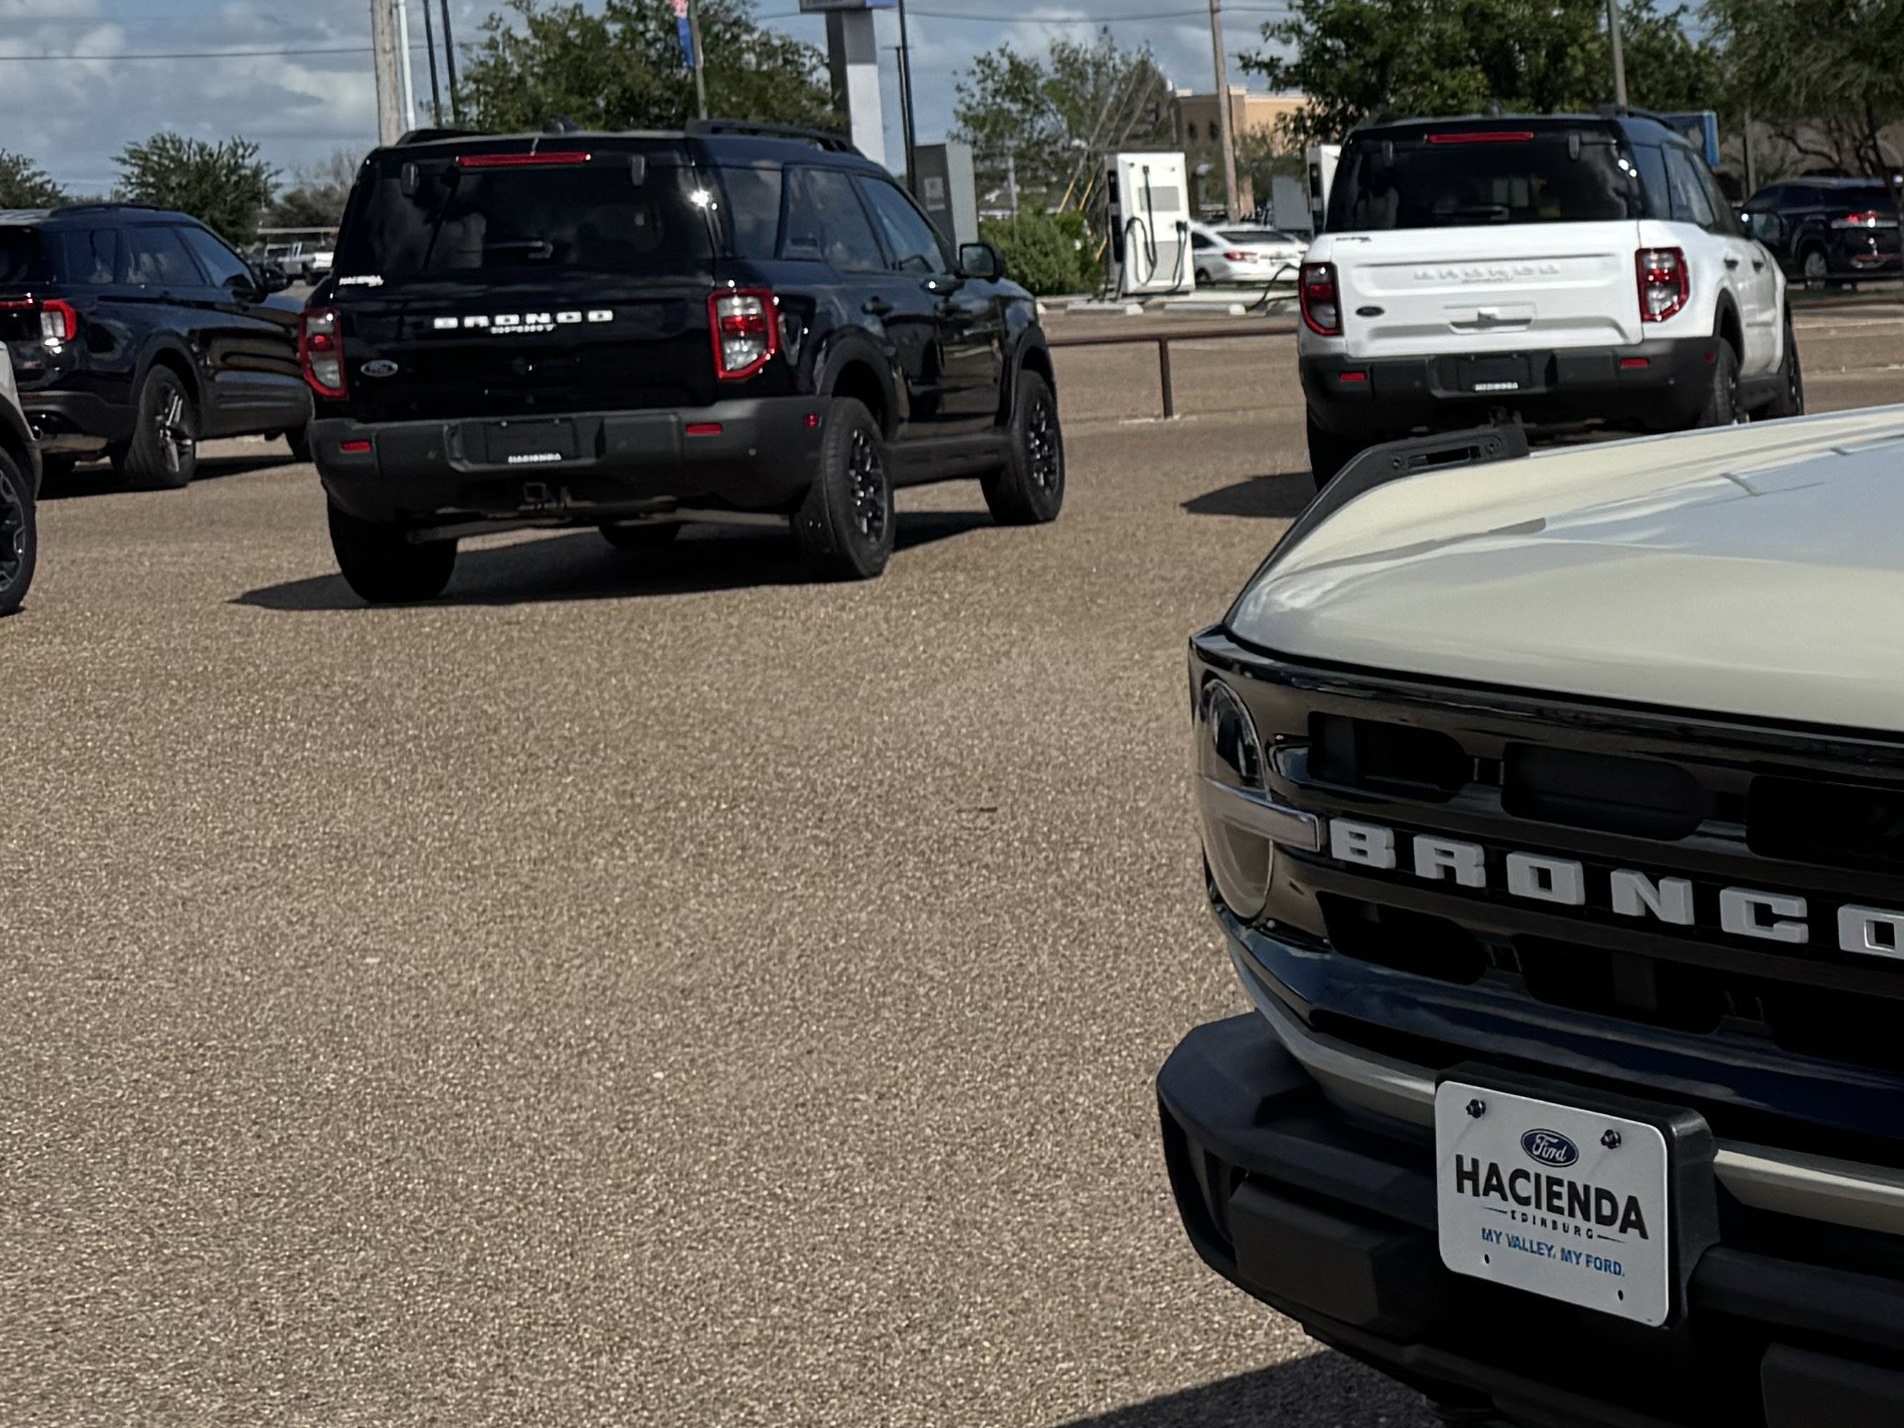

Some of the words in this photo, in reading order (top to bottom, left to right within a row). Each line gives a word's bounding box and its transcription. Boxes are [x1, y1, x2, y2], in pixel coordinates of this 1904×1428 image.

[434, 310, 613, 329] BRONCO
[1532, 1133, 1567, 1162] Ford
[1455, 1154, 1649, 1240] HACIENDA
[1510, 1209, 1594, 1239] EDINBURG
[1481, 1227, 1503, 1244] MY
[1560, 1248, 1582, 1265] MY
[1585, 1254, 1626, 1277] FORD.
